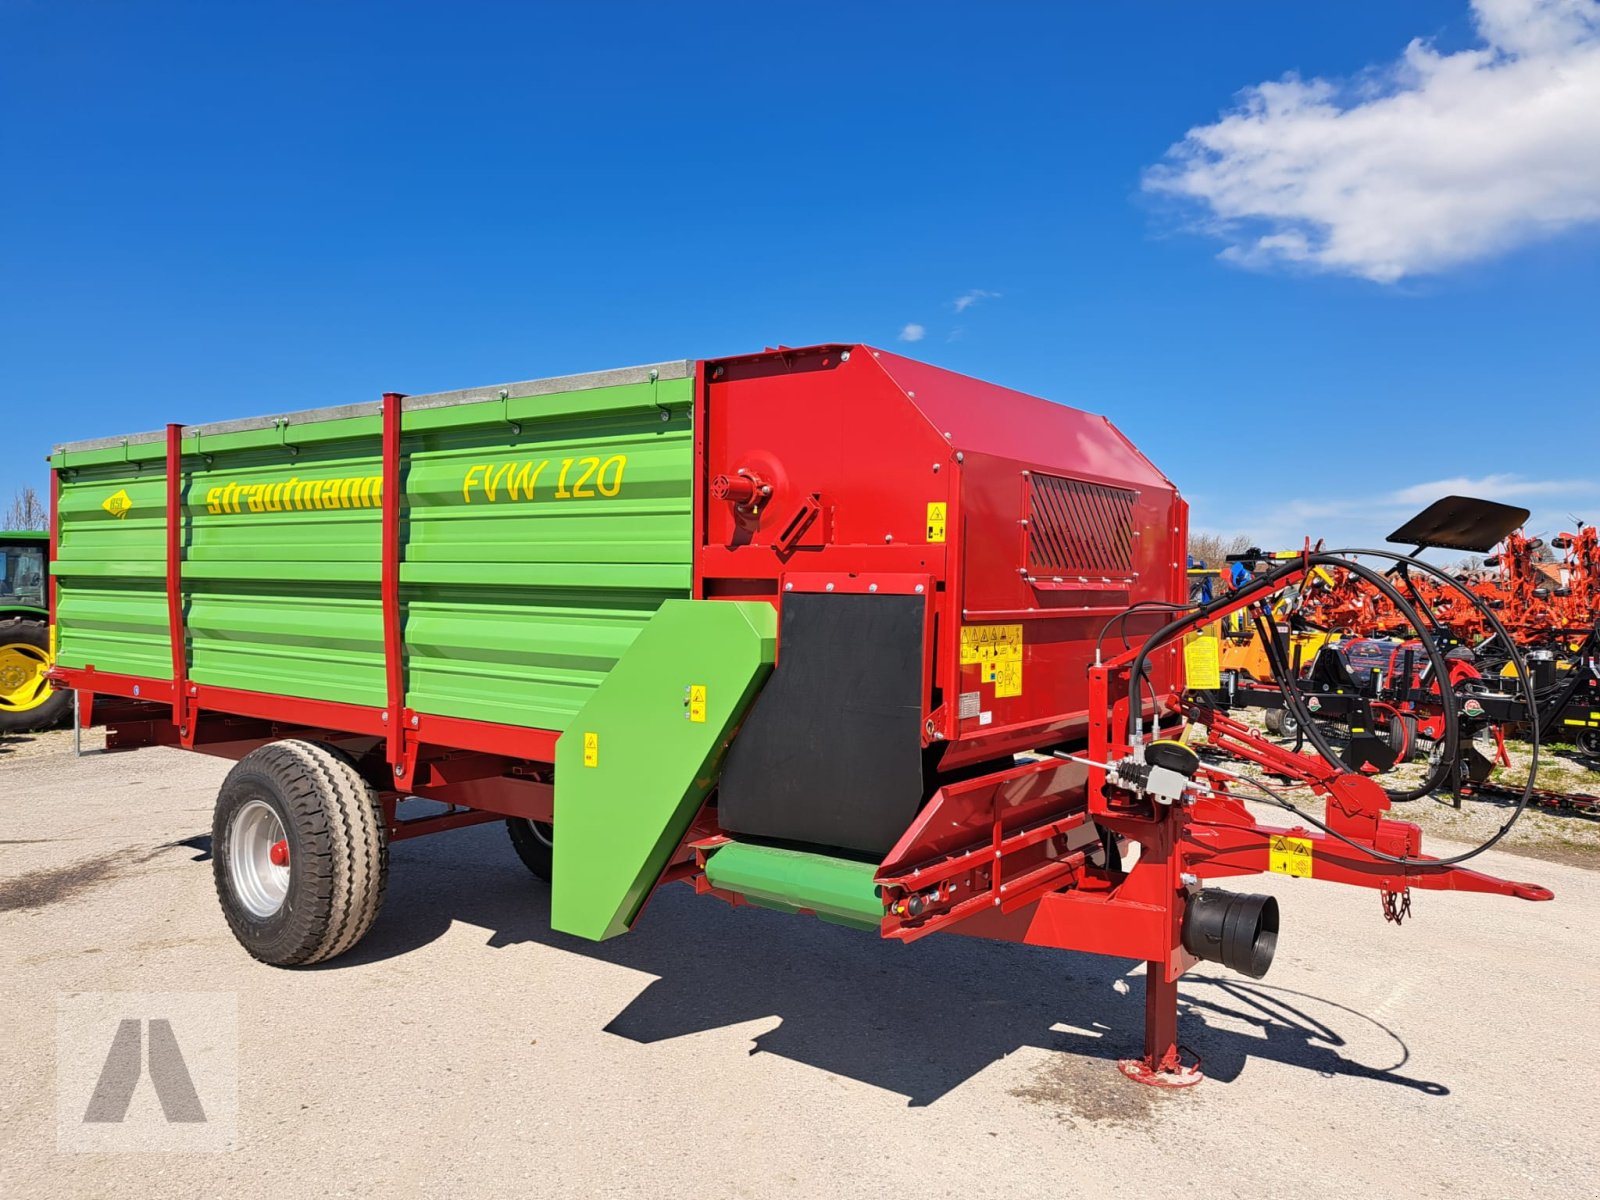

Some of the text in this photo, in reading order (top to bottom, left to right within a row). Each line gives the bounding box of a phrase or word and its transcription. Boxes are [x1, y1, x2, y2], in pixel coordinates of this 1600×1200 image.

[207, 476, 383, 514] strautmann
[463, 454, 627, 503] FVW 120
